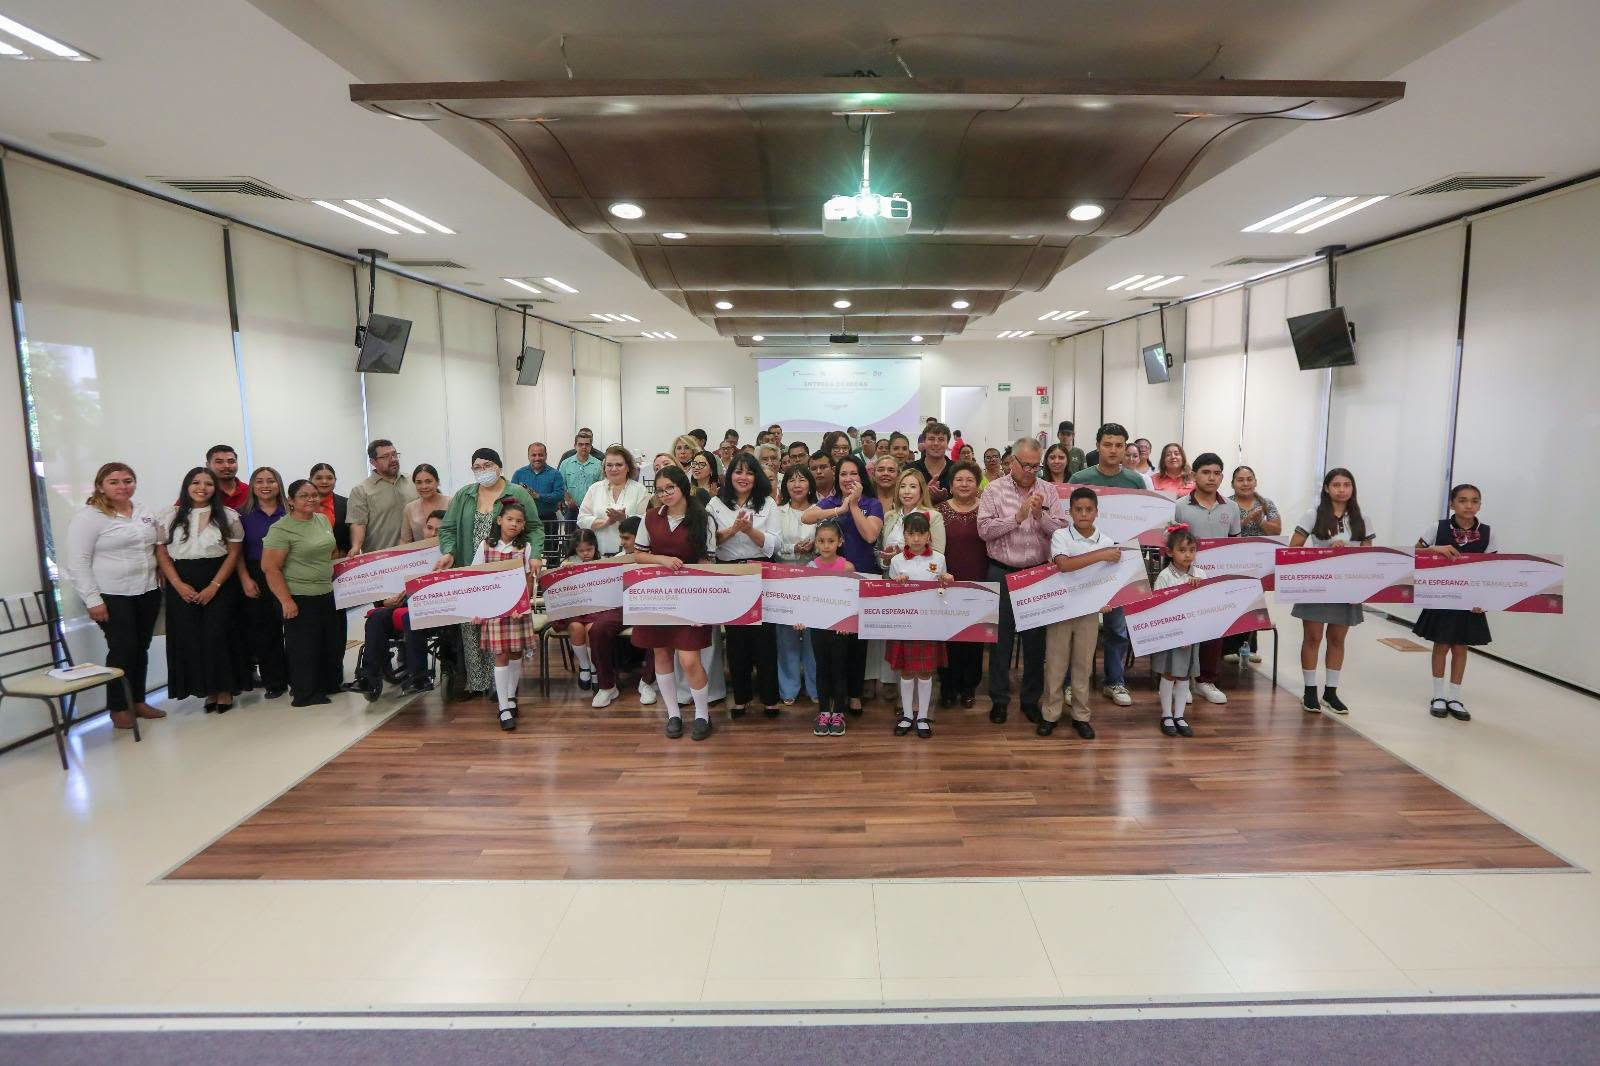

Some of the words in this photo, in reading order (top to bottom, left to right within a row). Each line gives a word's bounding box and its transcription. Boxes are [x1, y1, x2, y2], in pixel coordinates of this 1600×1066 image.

[378, 564, 408, 574] INCLUSIÓN
[409, 560, 428, 568] SOCIAL
[413, 594, 428, 602] BECA
[452, 586, 481, 596] INCLUSIÓN
[482, 584, 502, 592] SOCIAL
[547, 587, 562, 595] BECA
[586, 577, 616, 587] INCLUSIÓN
[765, 592, 800, 600] ESPERANZA
[811, 597, 851, 606] TAMAULIPAS
[1016, 598, 1032, 607] BECA
[1032, 588, 1067, 602] ESPERANZA
[1133, 622, 1149, 631] BECA
[1150, 614, 1186, 627] ESPERANZA
[1197, 602, 1236, 616] TAMAULIPAS
